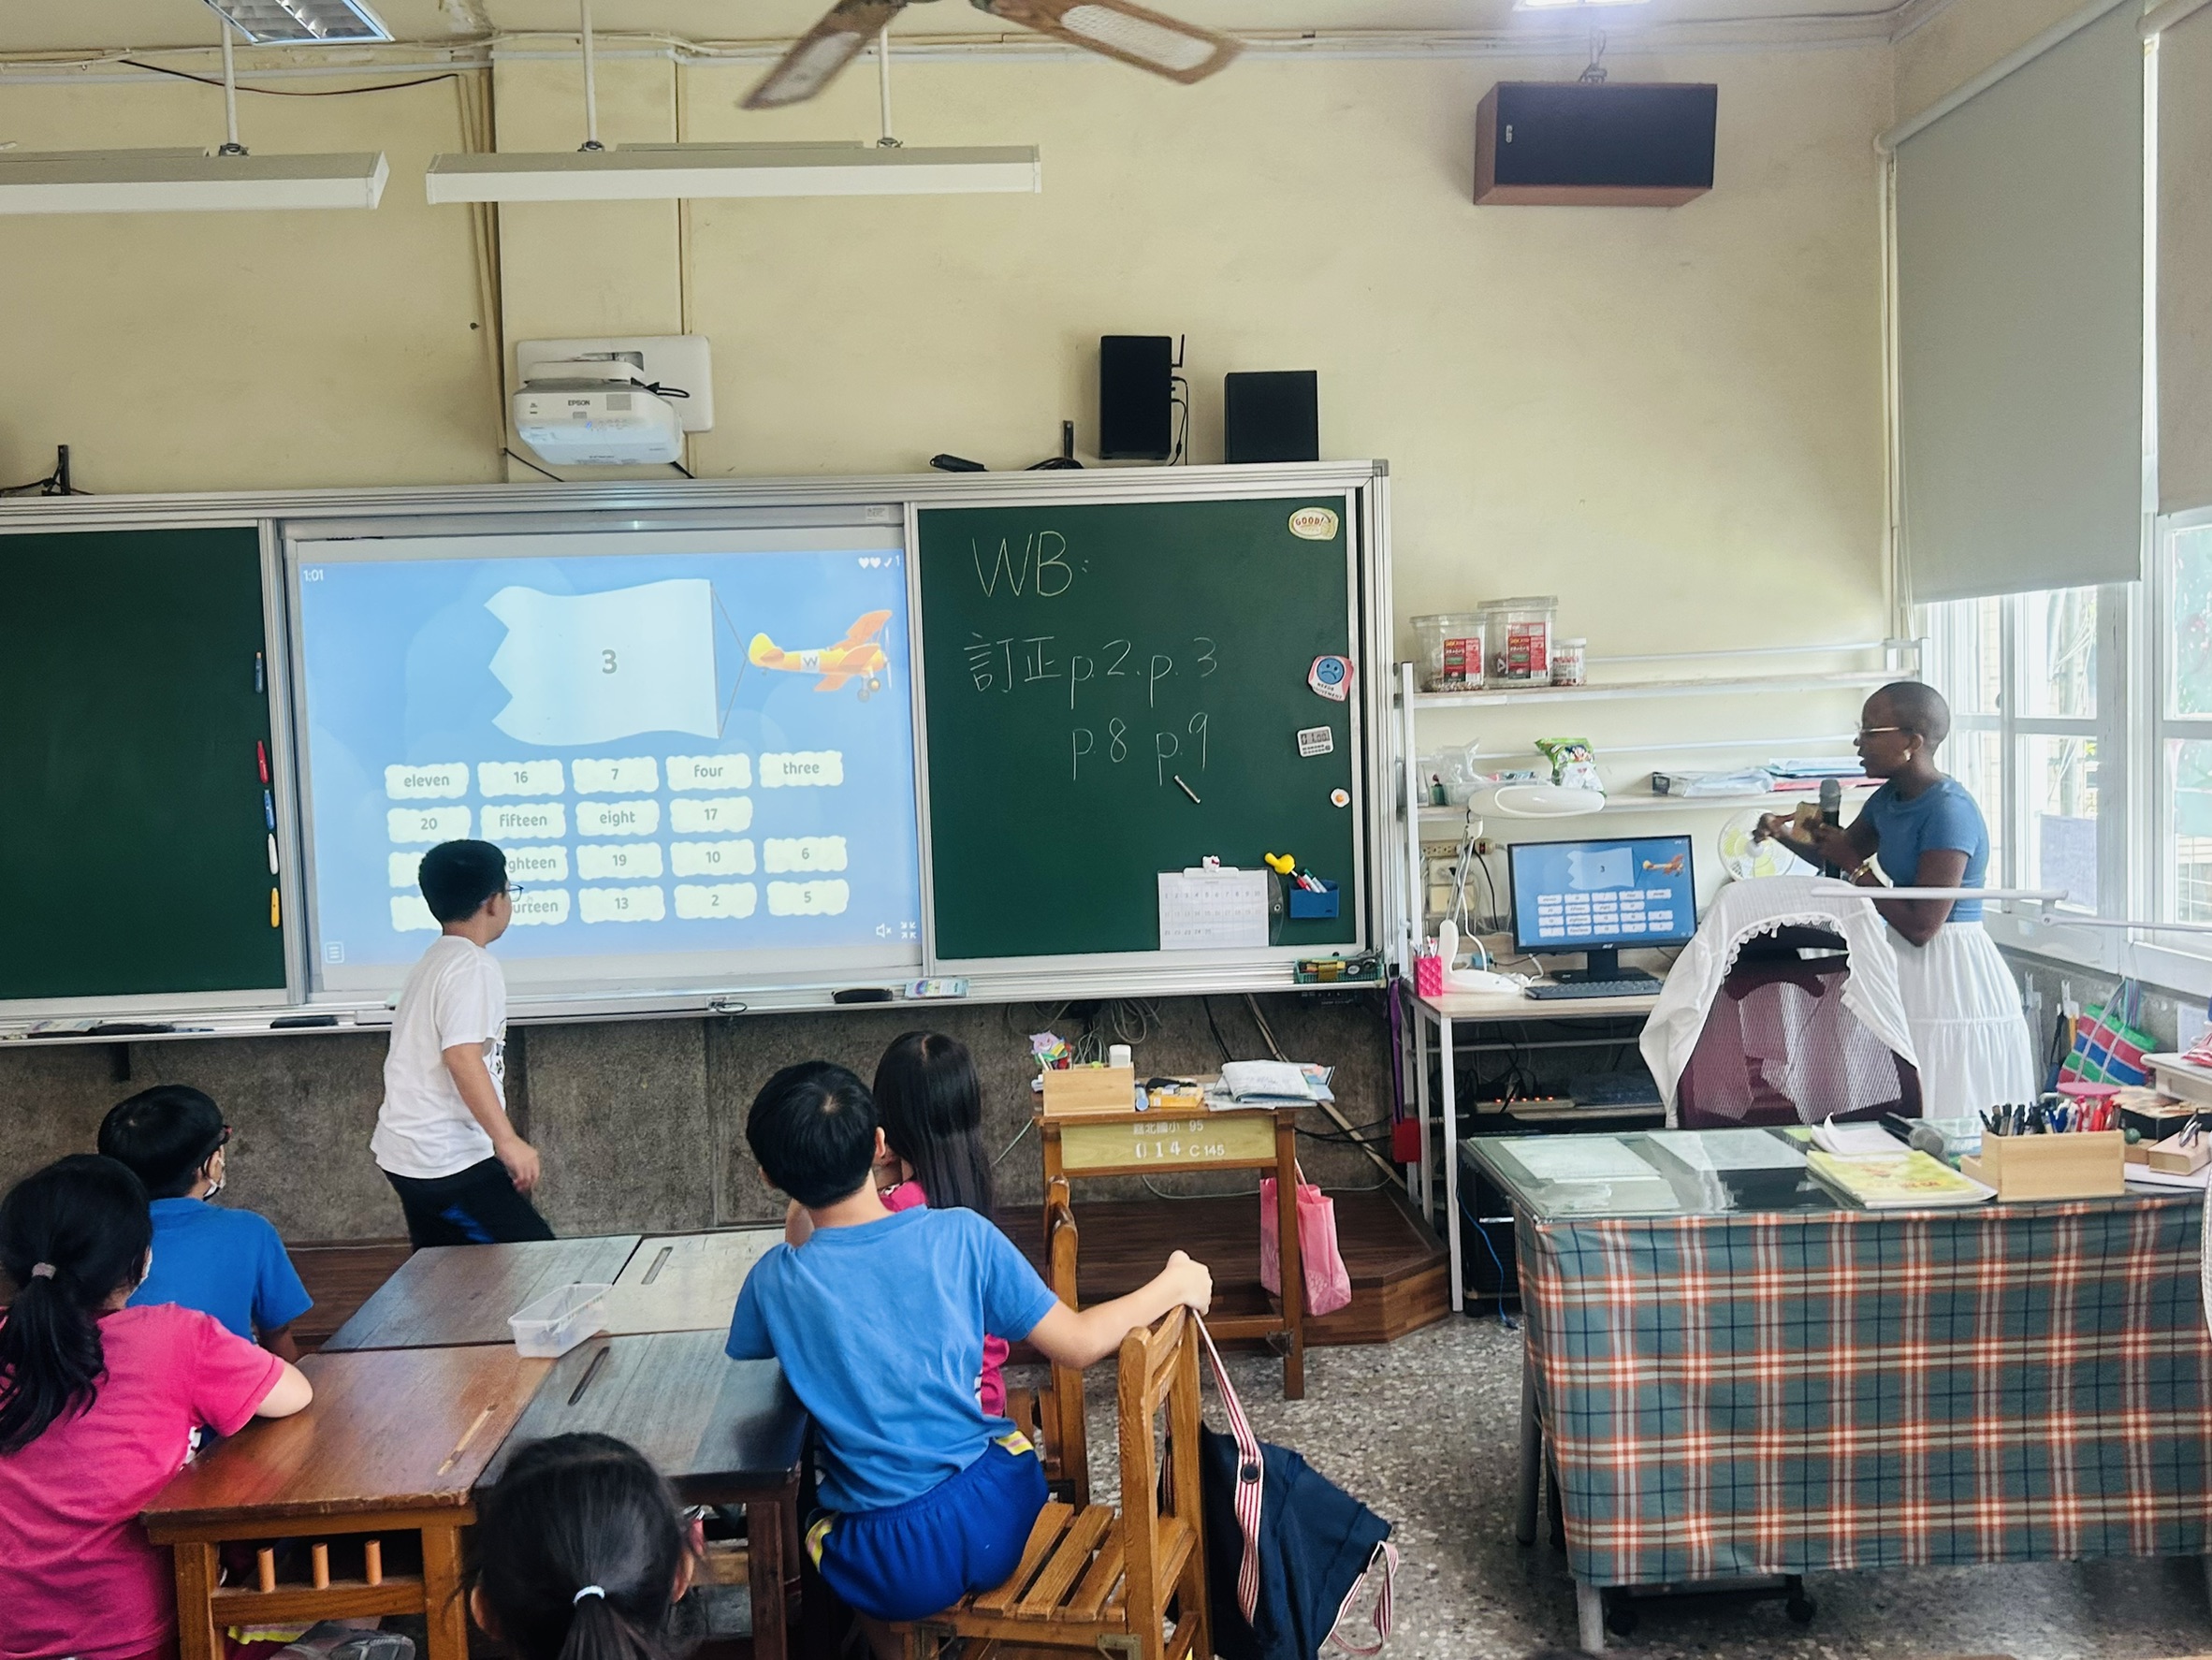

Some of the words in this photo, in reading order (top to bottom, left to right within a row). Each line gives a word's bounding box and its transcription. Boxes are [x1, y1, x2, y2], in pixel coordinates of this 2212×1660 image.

[895, 555, 900, 566] 1
[303, 570, 324, 581] 1:01
[602, 648, 618, 674] 3
[803, 657, 818, 667] W
[404, 774, 450, 788] eleven
[513, 770, 529, 783] 16
[611, 768, 619, 780] 7
[693, 764, 724, 778] four
[782, 761, 821, 776] three
[420, 817, 438, 830] 20
[499, 813, 548, 828] fifteen
[599, 809, 636, 826] eight
[704, 808, 718, 821] 17
[508, 856, 557, 874] ghteen
[612, 853, 627, 866] 19
[706, 851, 721, 864] 10
[801, 847, 810, 860] 6
[1599, 865, 1606, 873] 3
[512, 896, 559, 914] urteen
[615, 896, 630, 910] 13
[711, 894, 720, 907] 2
[804, 890, 812, 904] 5
[1189, 1119, 1204, 1132] 95
[1204, 1143, 1225, 1157] 145
